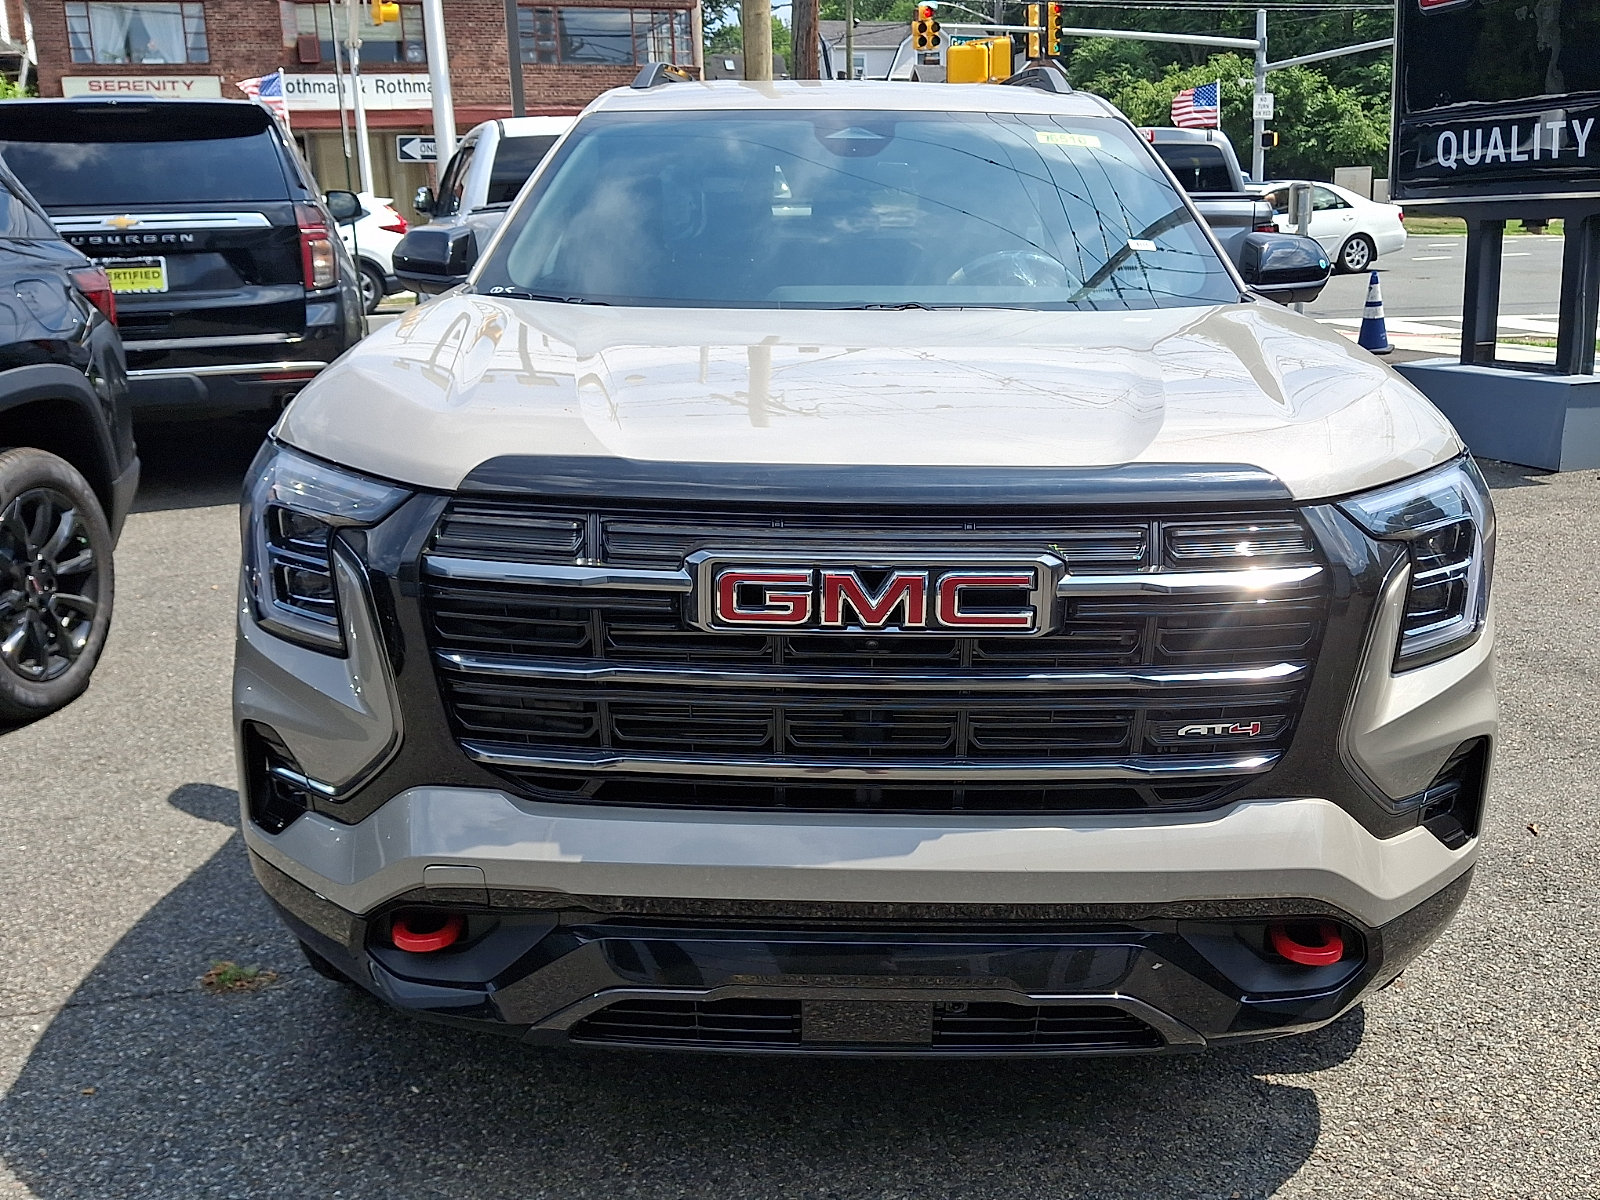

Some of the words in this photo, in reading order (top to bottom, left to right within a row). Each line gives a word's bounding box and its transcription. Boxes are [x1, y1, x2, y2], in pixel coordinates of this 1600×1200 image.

[88, 80, 194, 91] SERENITY
[286, 78, 346, 94] othman
[375, 78, 431, 94] Rothma
[1437, 118, 1594, 170] QUALITY
[71, 234, 194, 246] UBURBAN
[106, 269, 161, 281] ERTIFIED
[715, 566, 1035, 629] GMC
[1177, 721, 1261, 737] AT4
